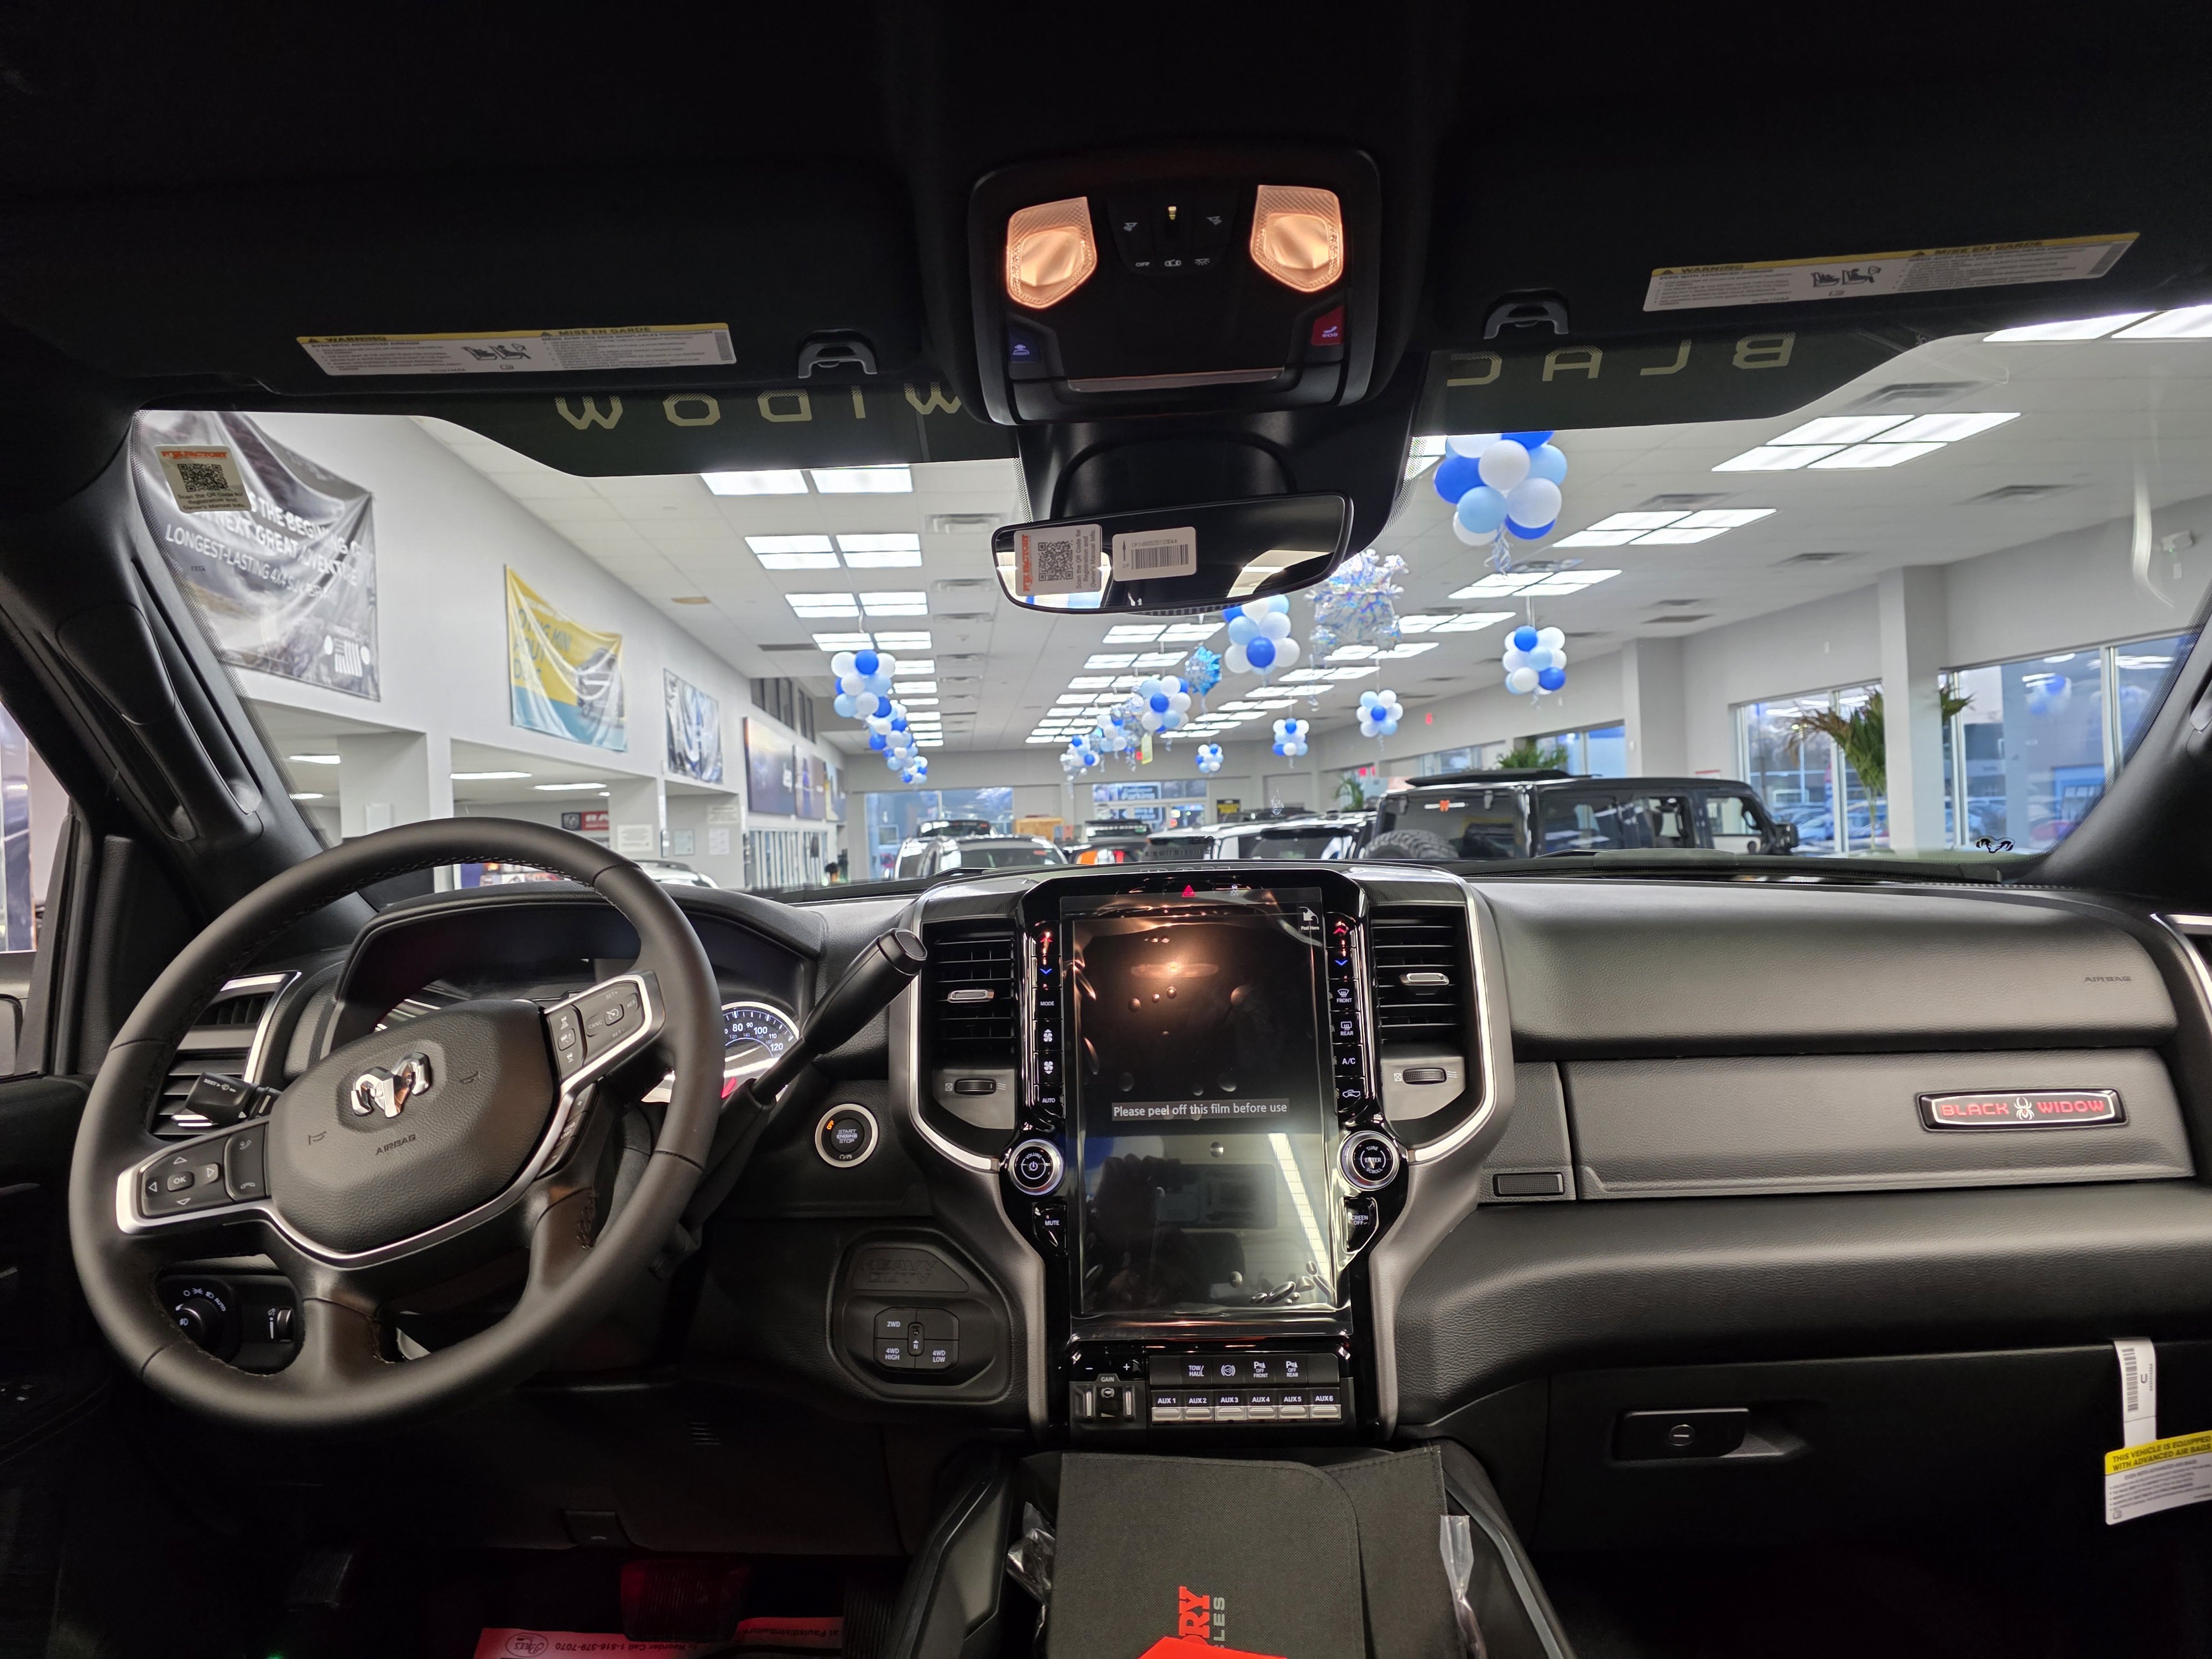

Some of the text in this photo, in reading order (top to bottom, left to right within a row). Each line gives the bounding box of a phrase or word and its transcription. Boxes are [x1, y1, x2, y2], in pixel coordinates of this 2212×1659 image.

[1682, 265, 1744, 273] WARNING
[259, 497, 286, 527] THE
[213, 512, 252, 539] NEXT
[256, 524, 299, 558] GREAT
[166, 524, 270, 579] LONGEST-LASTING
[1022, 534, 1032, 573] FACTORY
[1076, 555, 1082, 563] QR
[627, 1000, 635, 1008] RES
[588, 1020, 603, 1029] CANC
[732, 1023, 743, 1032] 80
[754, 1026, 768, 1035] 100
[1114, 1107, 1145, 1117] Please
[1148, 1105, 1169, 1117] peel
[1172, 1104, 1187, 1115] off
[1190, 1104, 1208, 1114] this
[1211, 1104, 1230, 1114] film
[1233, 1103, 1266, 1113] before
[1940, 1100, 2105, 1116] BLACK WIDOW
[376, 1134, 416, 1155] AIRBAG
[173, 1176, 186, 1184] OK
[215, 1297, 226, 1312] AUTO
[2141, 1374, 2148, 1383] U
[2112, 1453, 2129, 1463] THIS
[2130, 1446, 2162, 1458] VEHICLE
[2172, 1436, 2211, 1448] EQUIPPED
[2112, 1443, 2211, 1471] WITH ADVANCED AIR BAGS
[1213, 1597, 1225, 1648] LES
